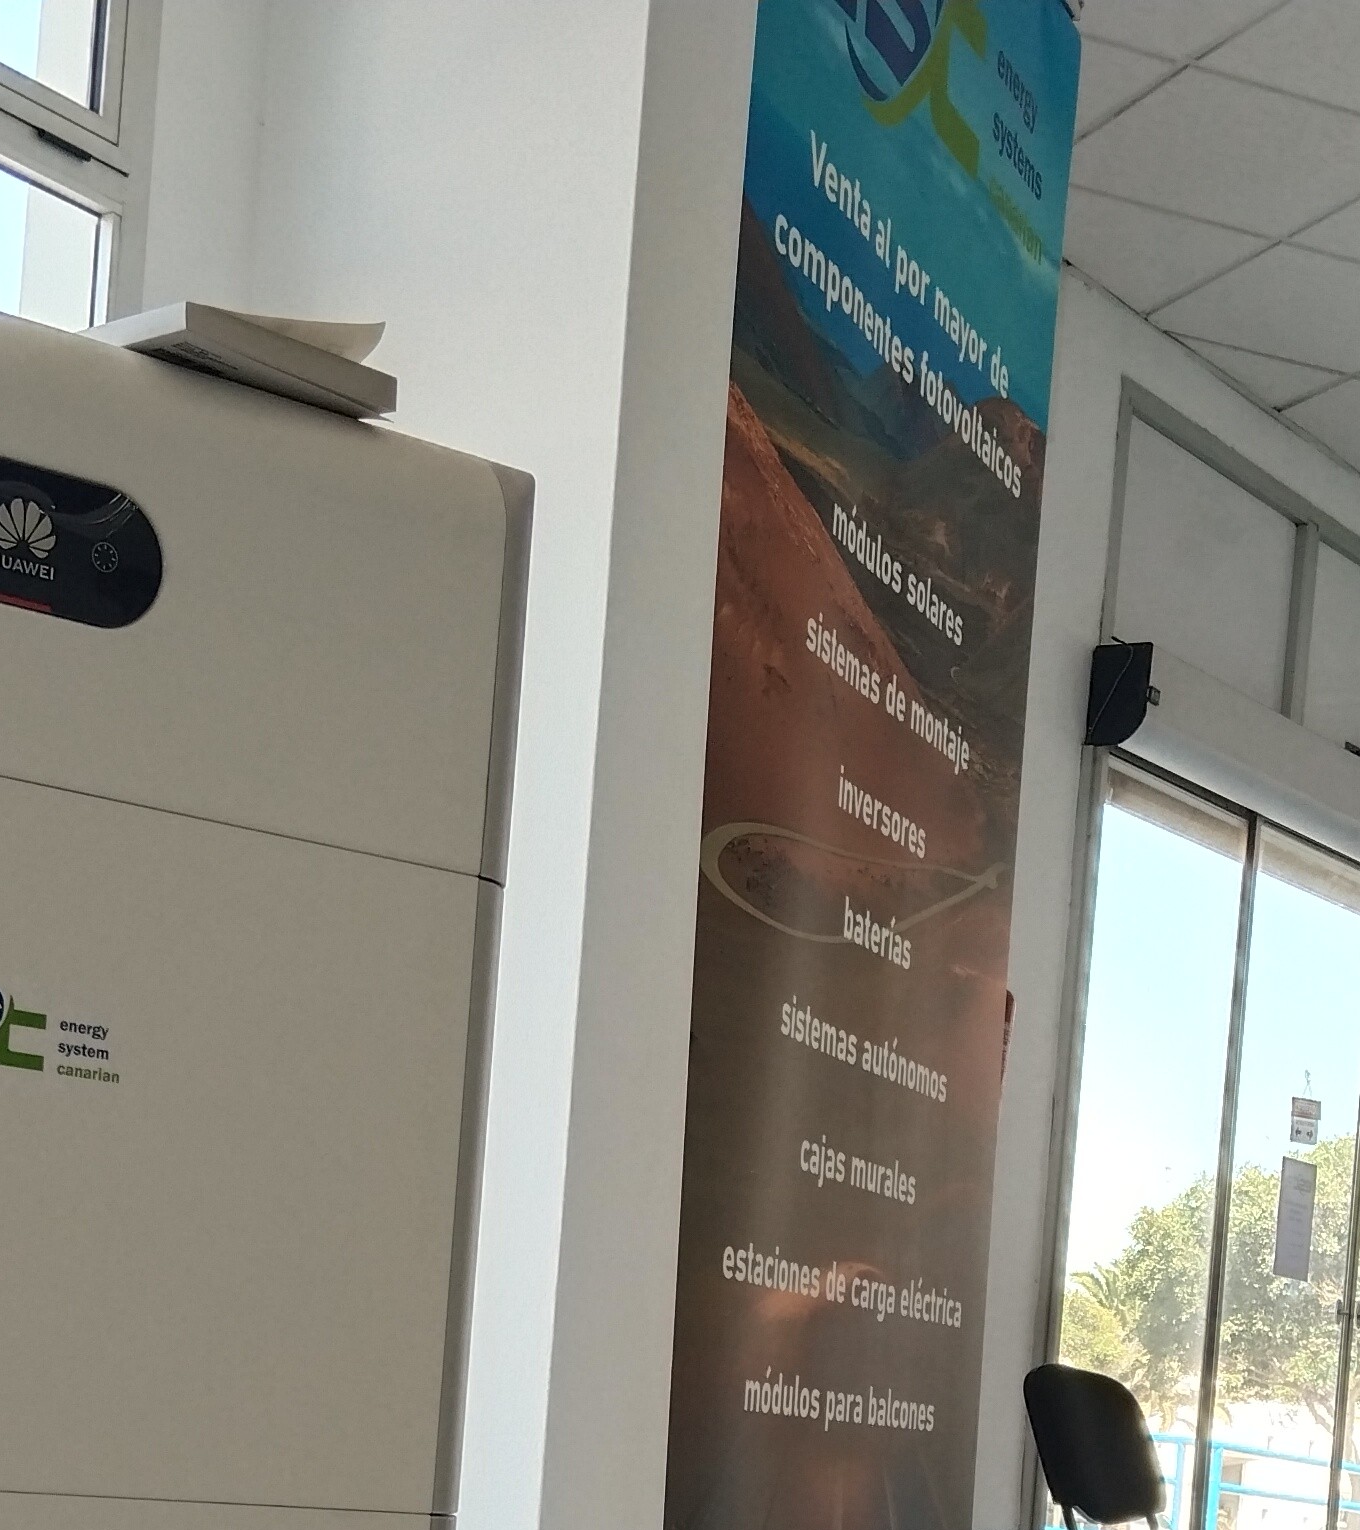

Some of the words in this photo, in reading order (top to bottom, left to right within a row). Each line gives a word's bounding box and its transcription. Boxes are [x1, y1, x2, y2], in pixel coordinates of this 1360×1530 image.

[997, 50, 1038, 134] energy
[992, 112, 1043, 201] systems
[810, 130, 871, 241] Venta
[875, 217, 891, 268] al
[894, 244, 930, 305] por
[934, 286, 987, 374] mayor
[990, 346, 1009, 399] de
[774, 213, 915, 385] componentes
[920, 351, 1022, 499] fotovoltaicos
[832, 502, 903, 594] módulos
[906, 572, 964, 646] solares
[806, 612, 881, 705] sistemas
[885, 675, 906, 722] de
[910, 699, 970, 776] montaje
[838, 765, 926, 859] inversores
[843, 895, 912, 970] baterías
[57, 1041, 110, 1061] system
[59, 1019, 109, 1041] energy
[780, 994, 858, 1066] sistemas
[861, 1036, 948, 1103] autónomos
[56, 1063, 120, 1084] canarian
[800, 1134, 846, 1187] cajas
[850, 1156, 917, 1205] murales
[722, 1242, 821, 1298] estaciones
[825, 1261, 846, 1303] de
[851, 1275, 895, 1322] carga
[900, 1277, 962, 1328] eléctrica
[743, 1365, 821, 1420] módulos
[824, 1389, 863, 1432] para
[867, 1386, 935, 1432] balcones
